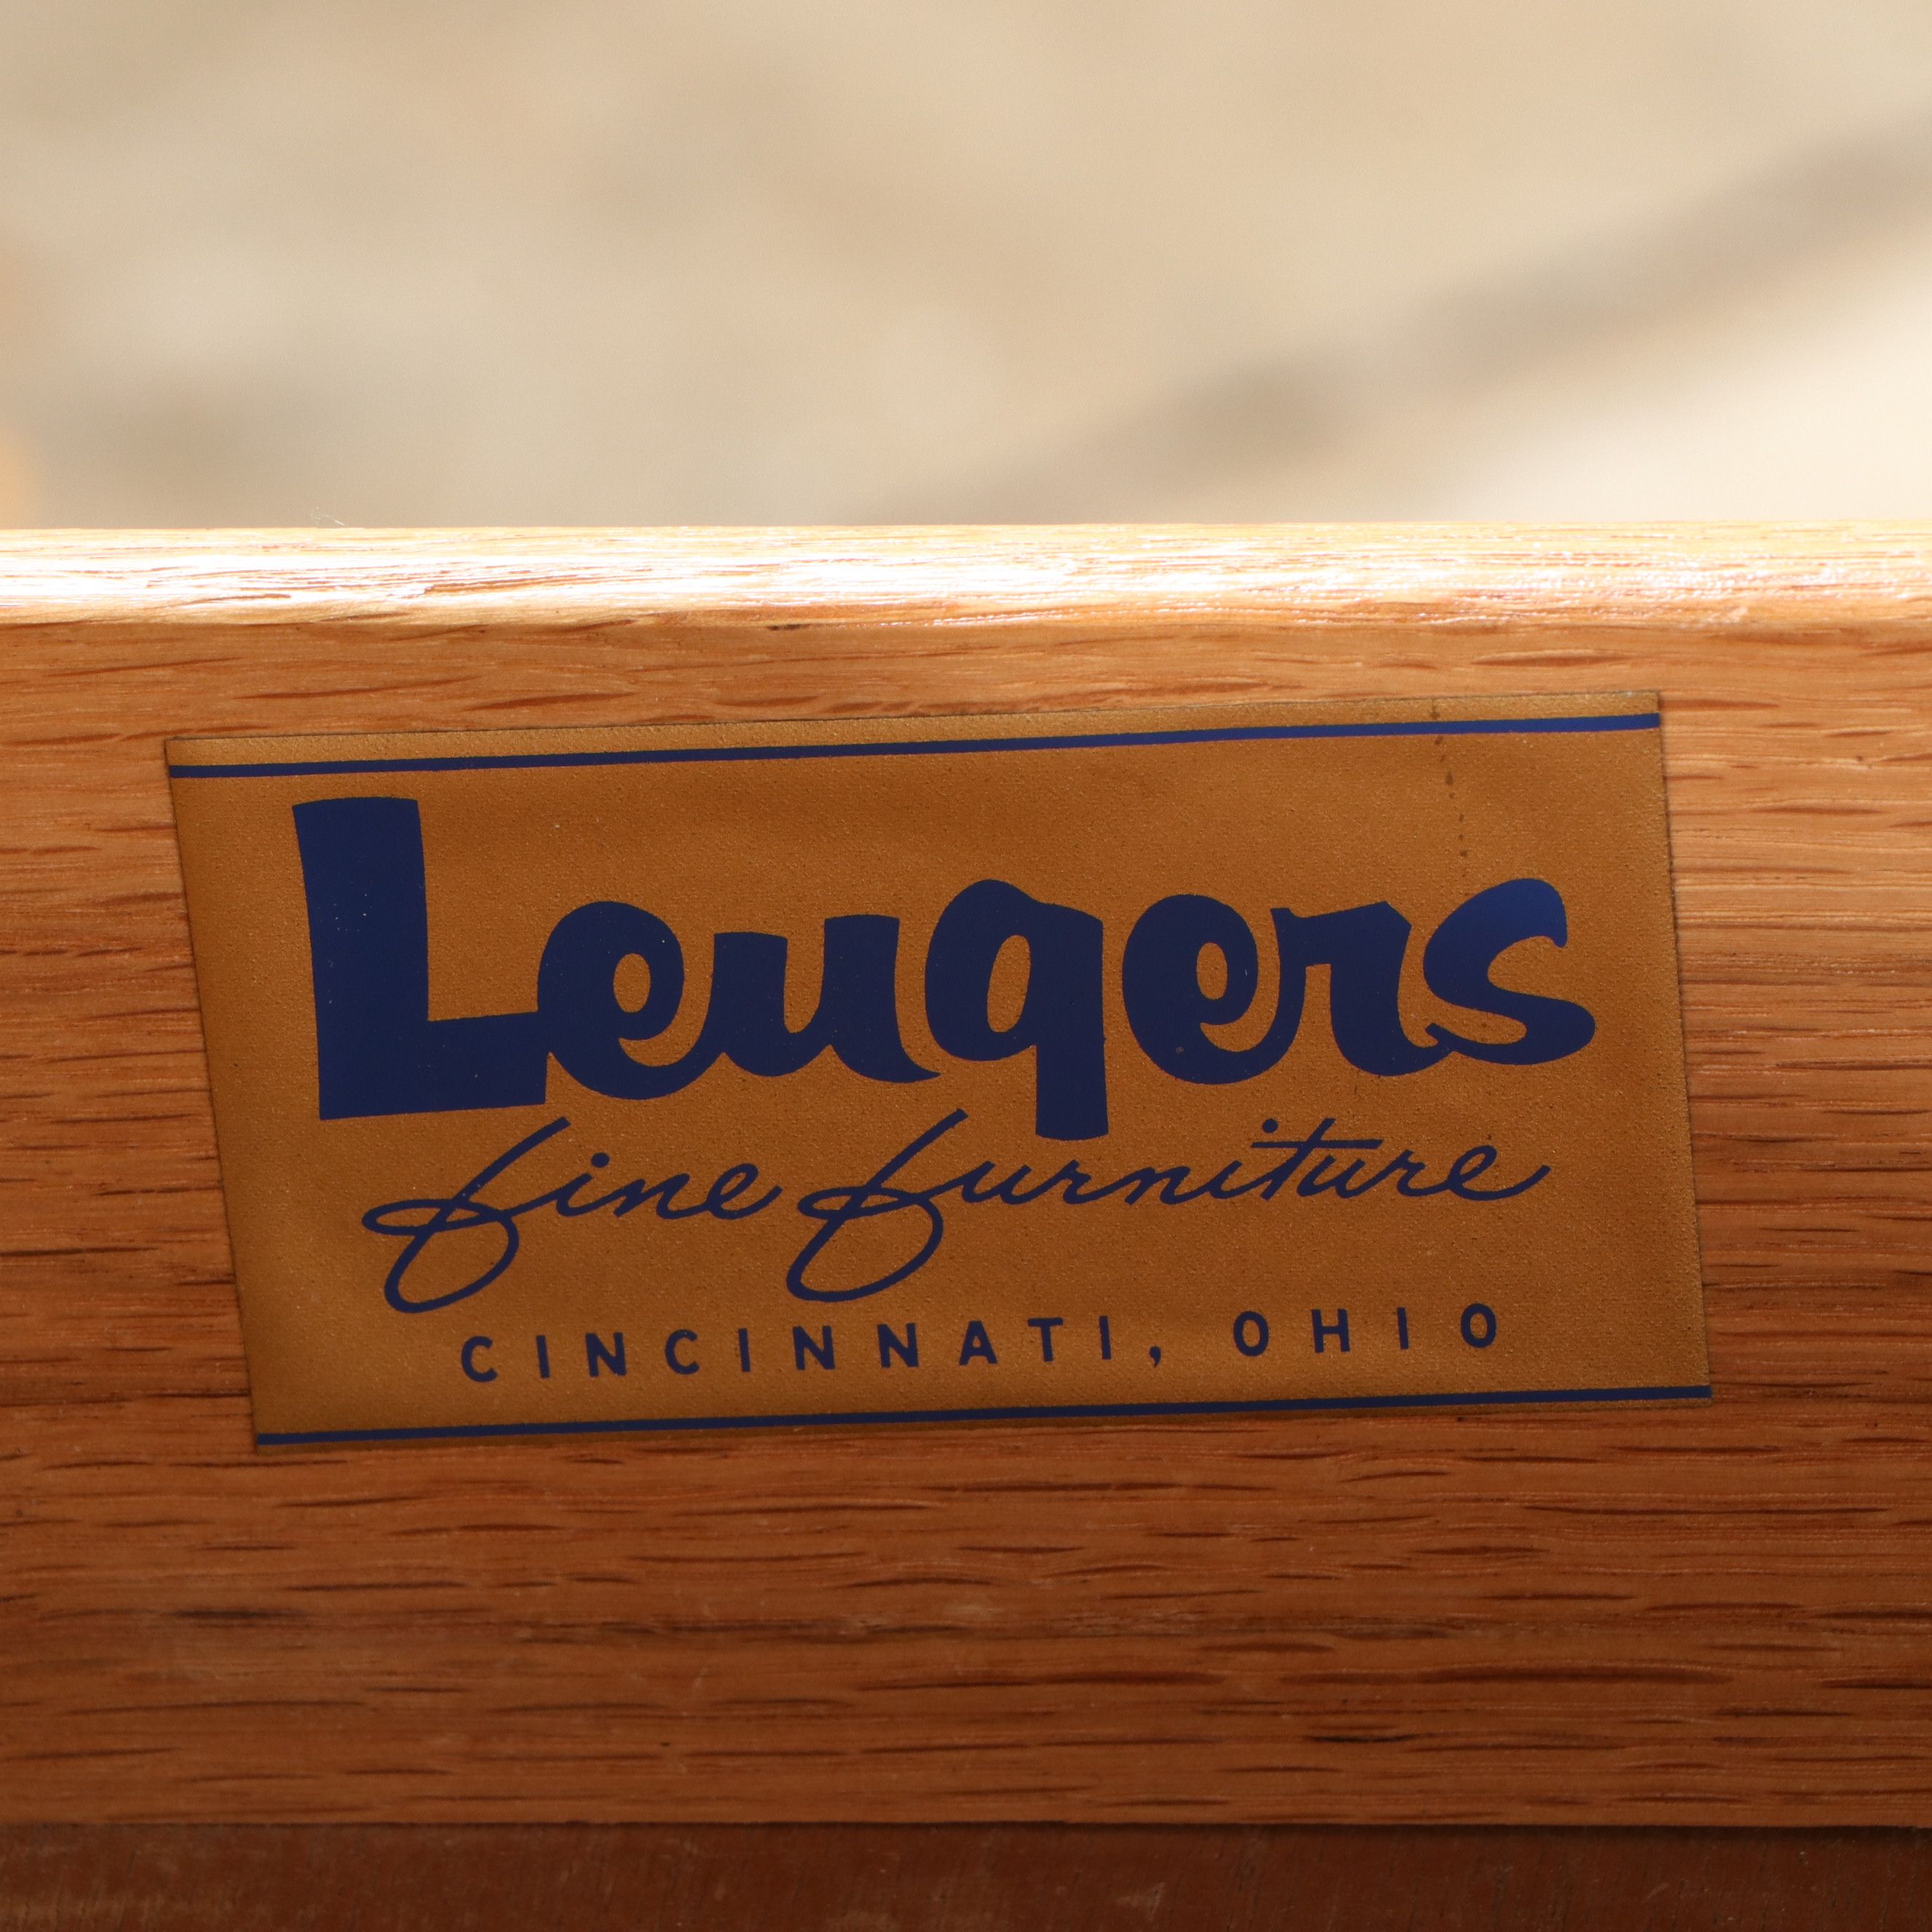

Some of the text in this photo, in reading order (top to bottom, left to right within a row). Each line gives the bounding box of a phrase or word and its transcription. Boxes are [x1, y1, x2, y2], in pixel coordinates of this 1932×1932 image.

[362, 1109, 1550, 1314] fine furniture
[462, 1304, 1498, 1382] CINCINNATI, OHIO
